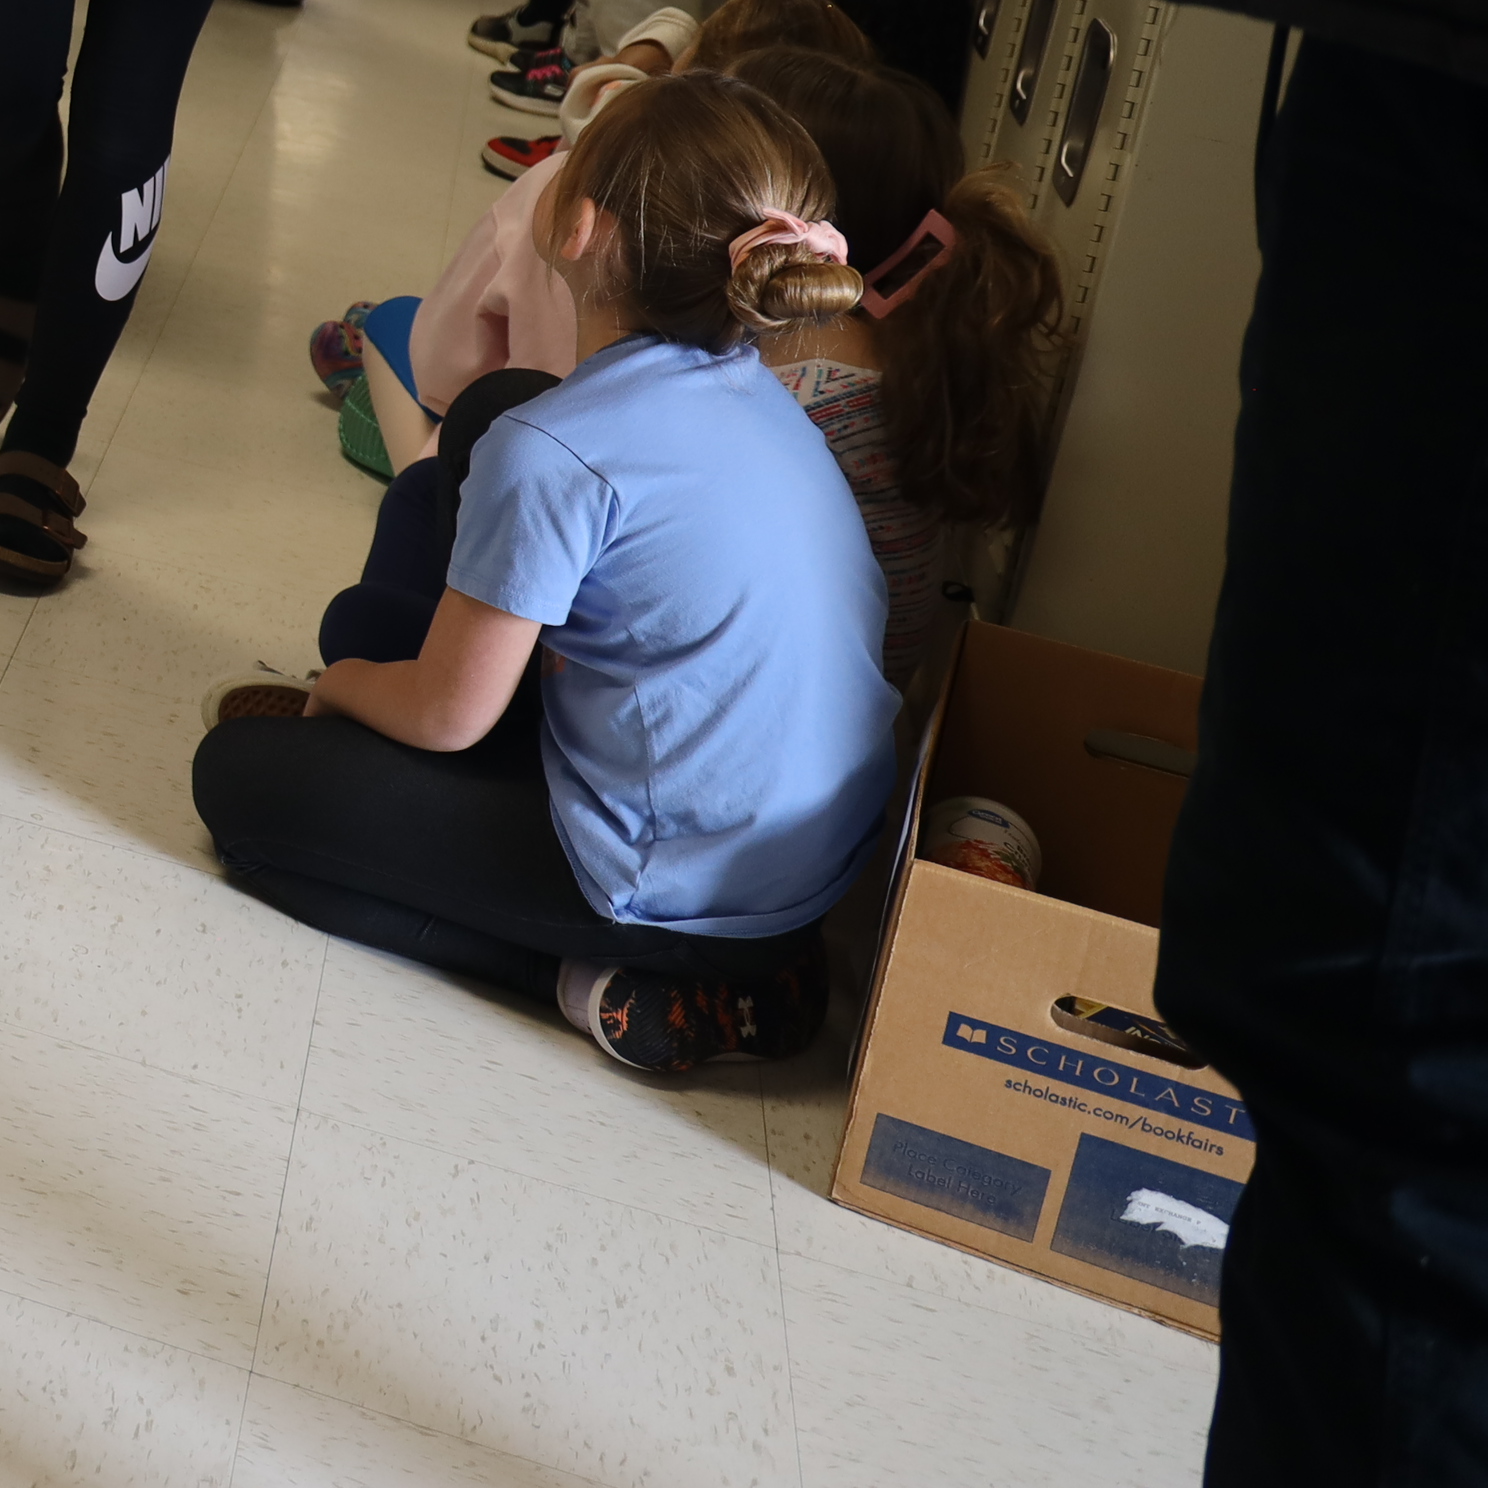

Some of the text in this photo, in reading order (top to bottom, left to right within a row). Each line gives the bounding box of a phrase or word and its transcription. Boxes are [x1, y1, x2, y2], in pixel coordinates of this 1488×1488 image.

[1004, 1076, 1225, 1157] scholastic.com/bookfairs
[893, 1141, 1023, 1196] Place Category
[908, 1164, 997, 1205] Label Here
